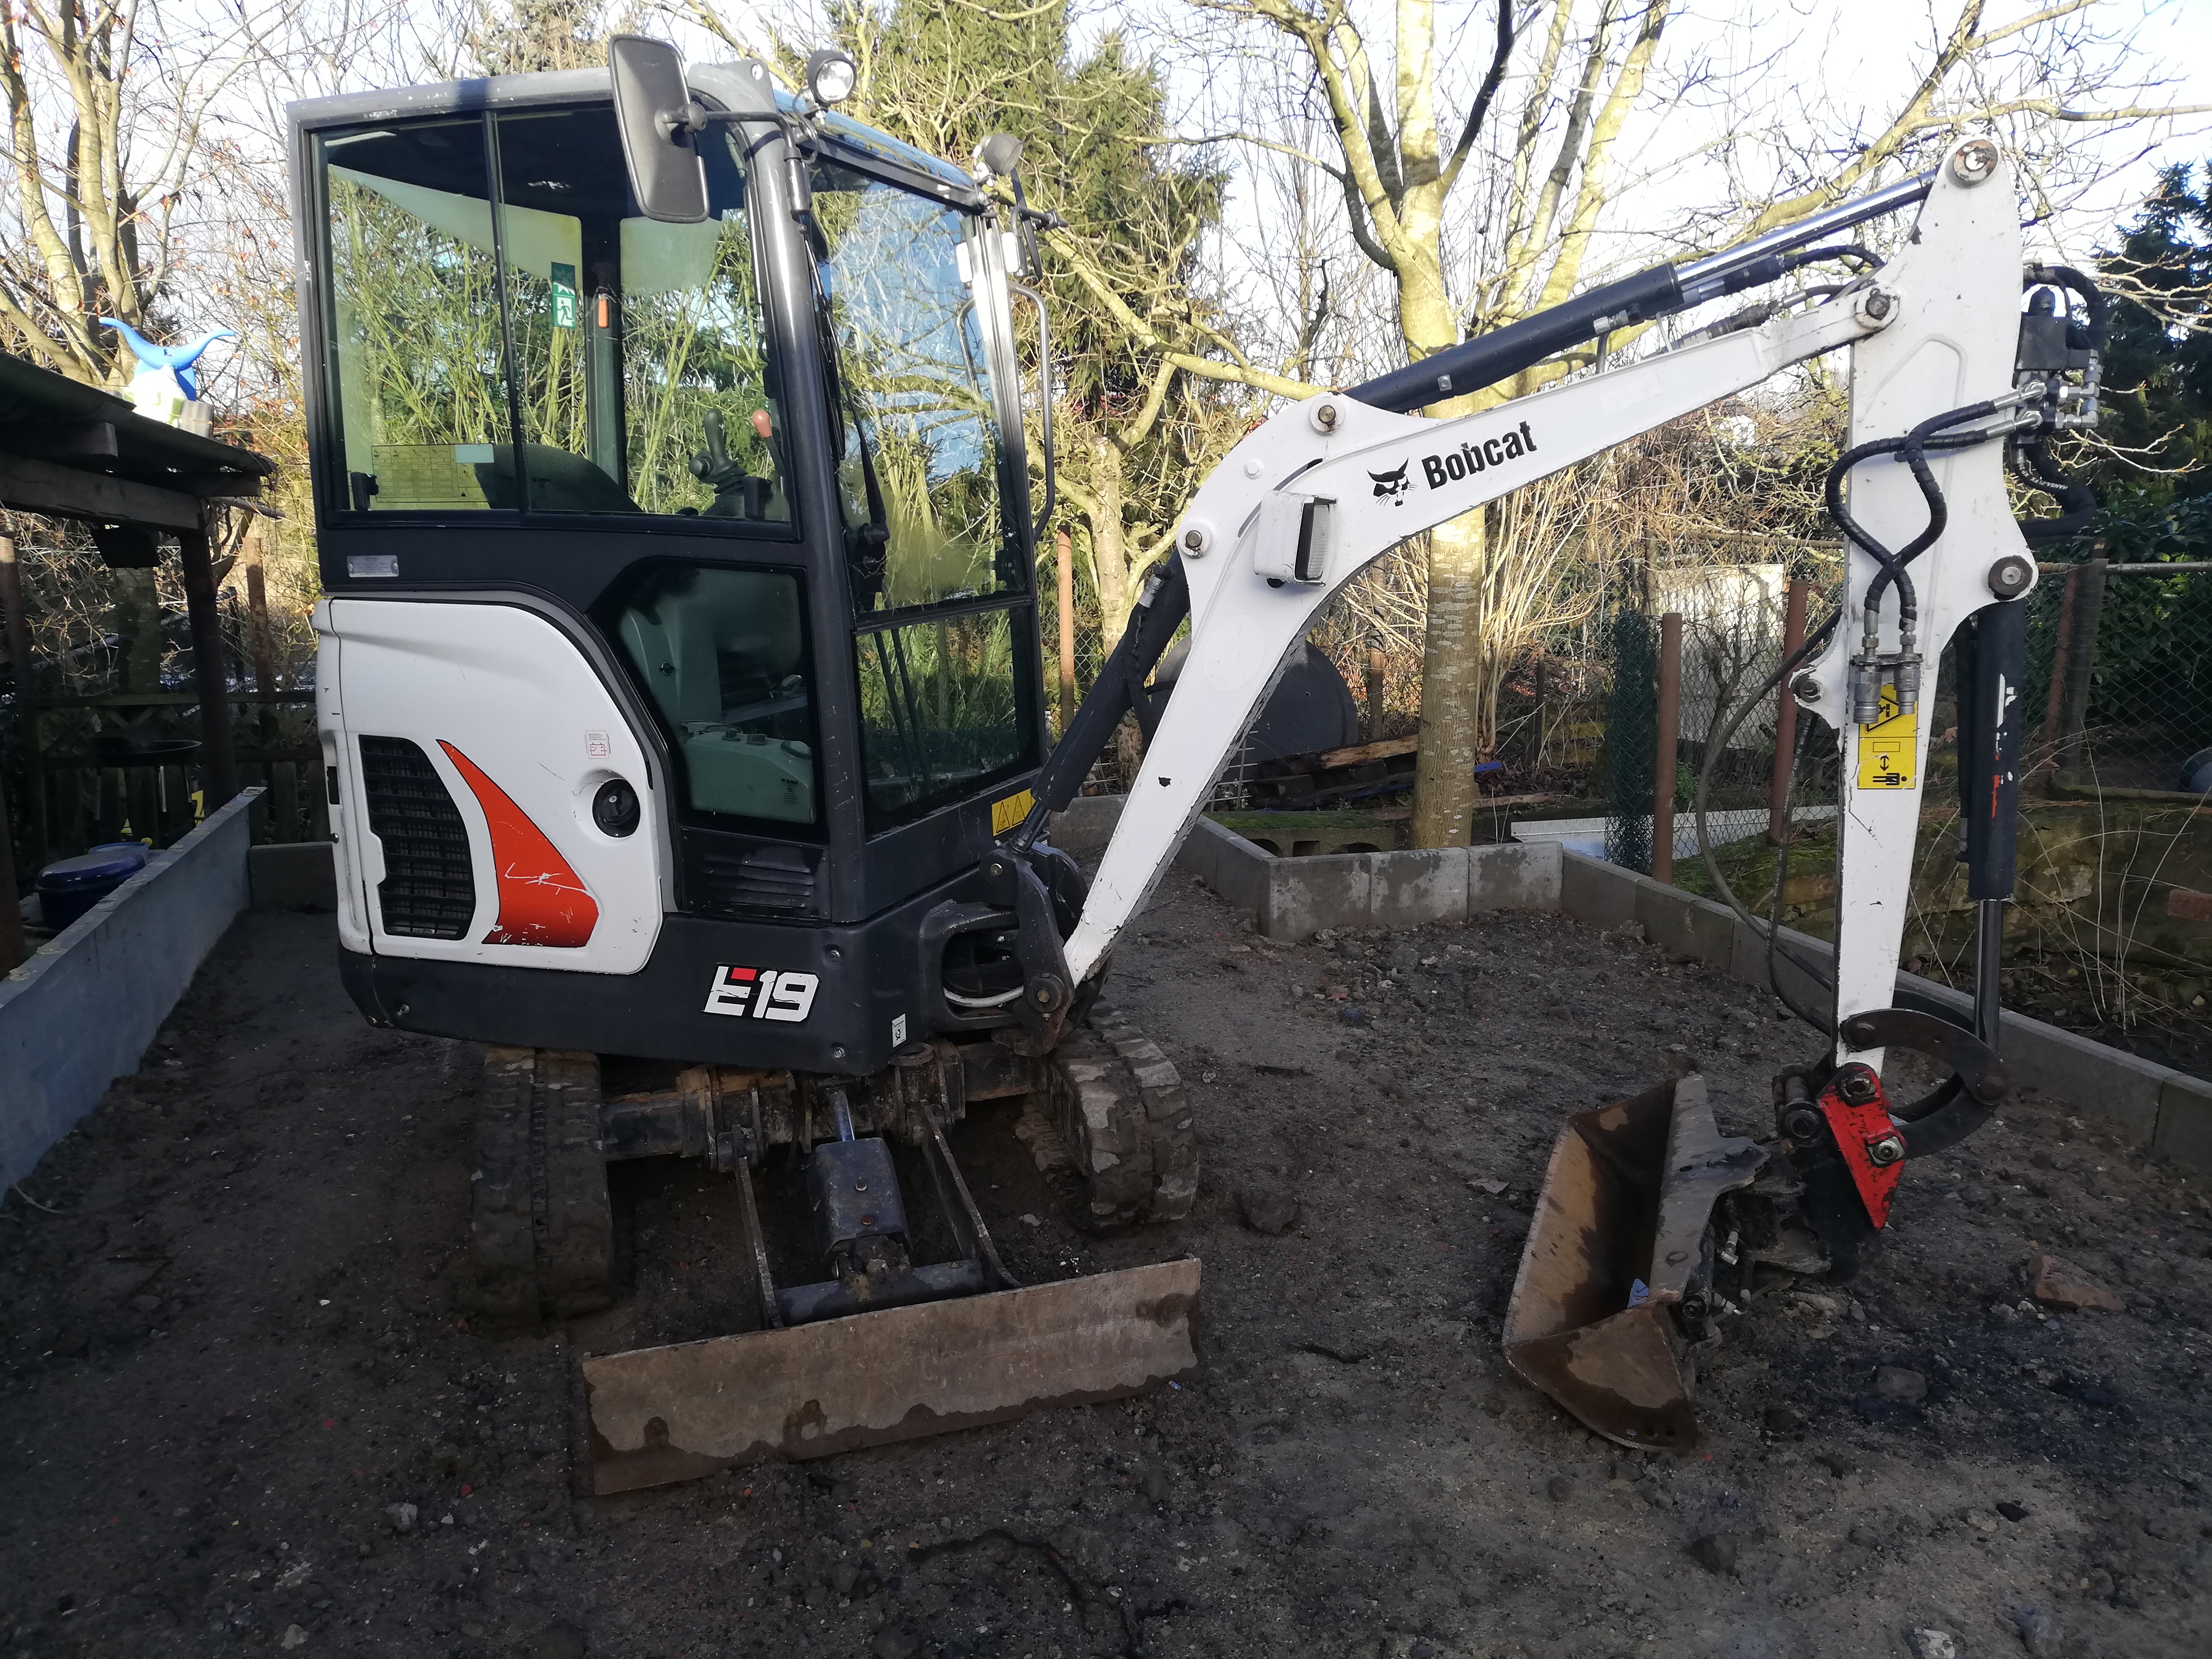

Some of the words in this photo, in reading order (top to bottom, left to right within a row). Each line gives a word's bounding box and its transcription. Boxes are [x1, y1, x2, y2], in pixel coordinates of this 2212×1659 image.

[1421, 421, 1538, 490] Bobcat
[2031, 476, 2068, 491] HANSA-FLEX
[704, 966, 819, 1022] E19
